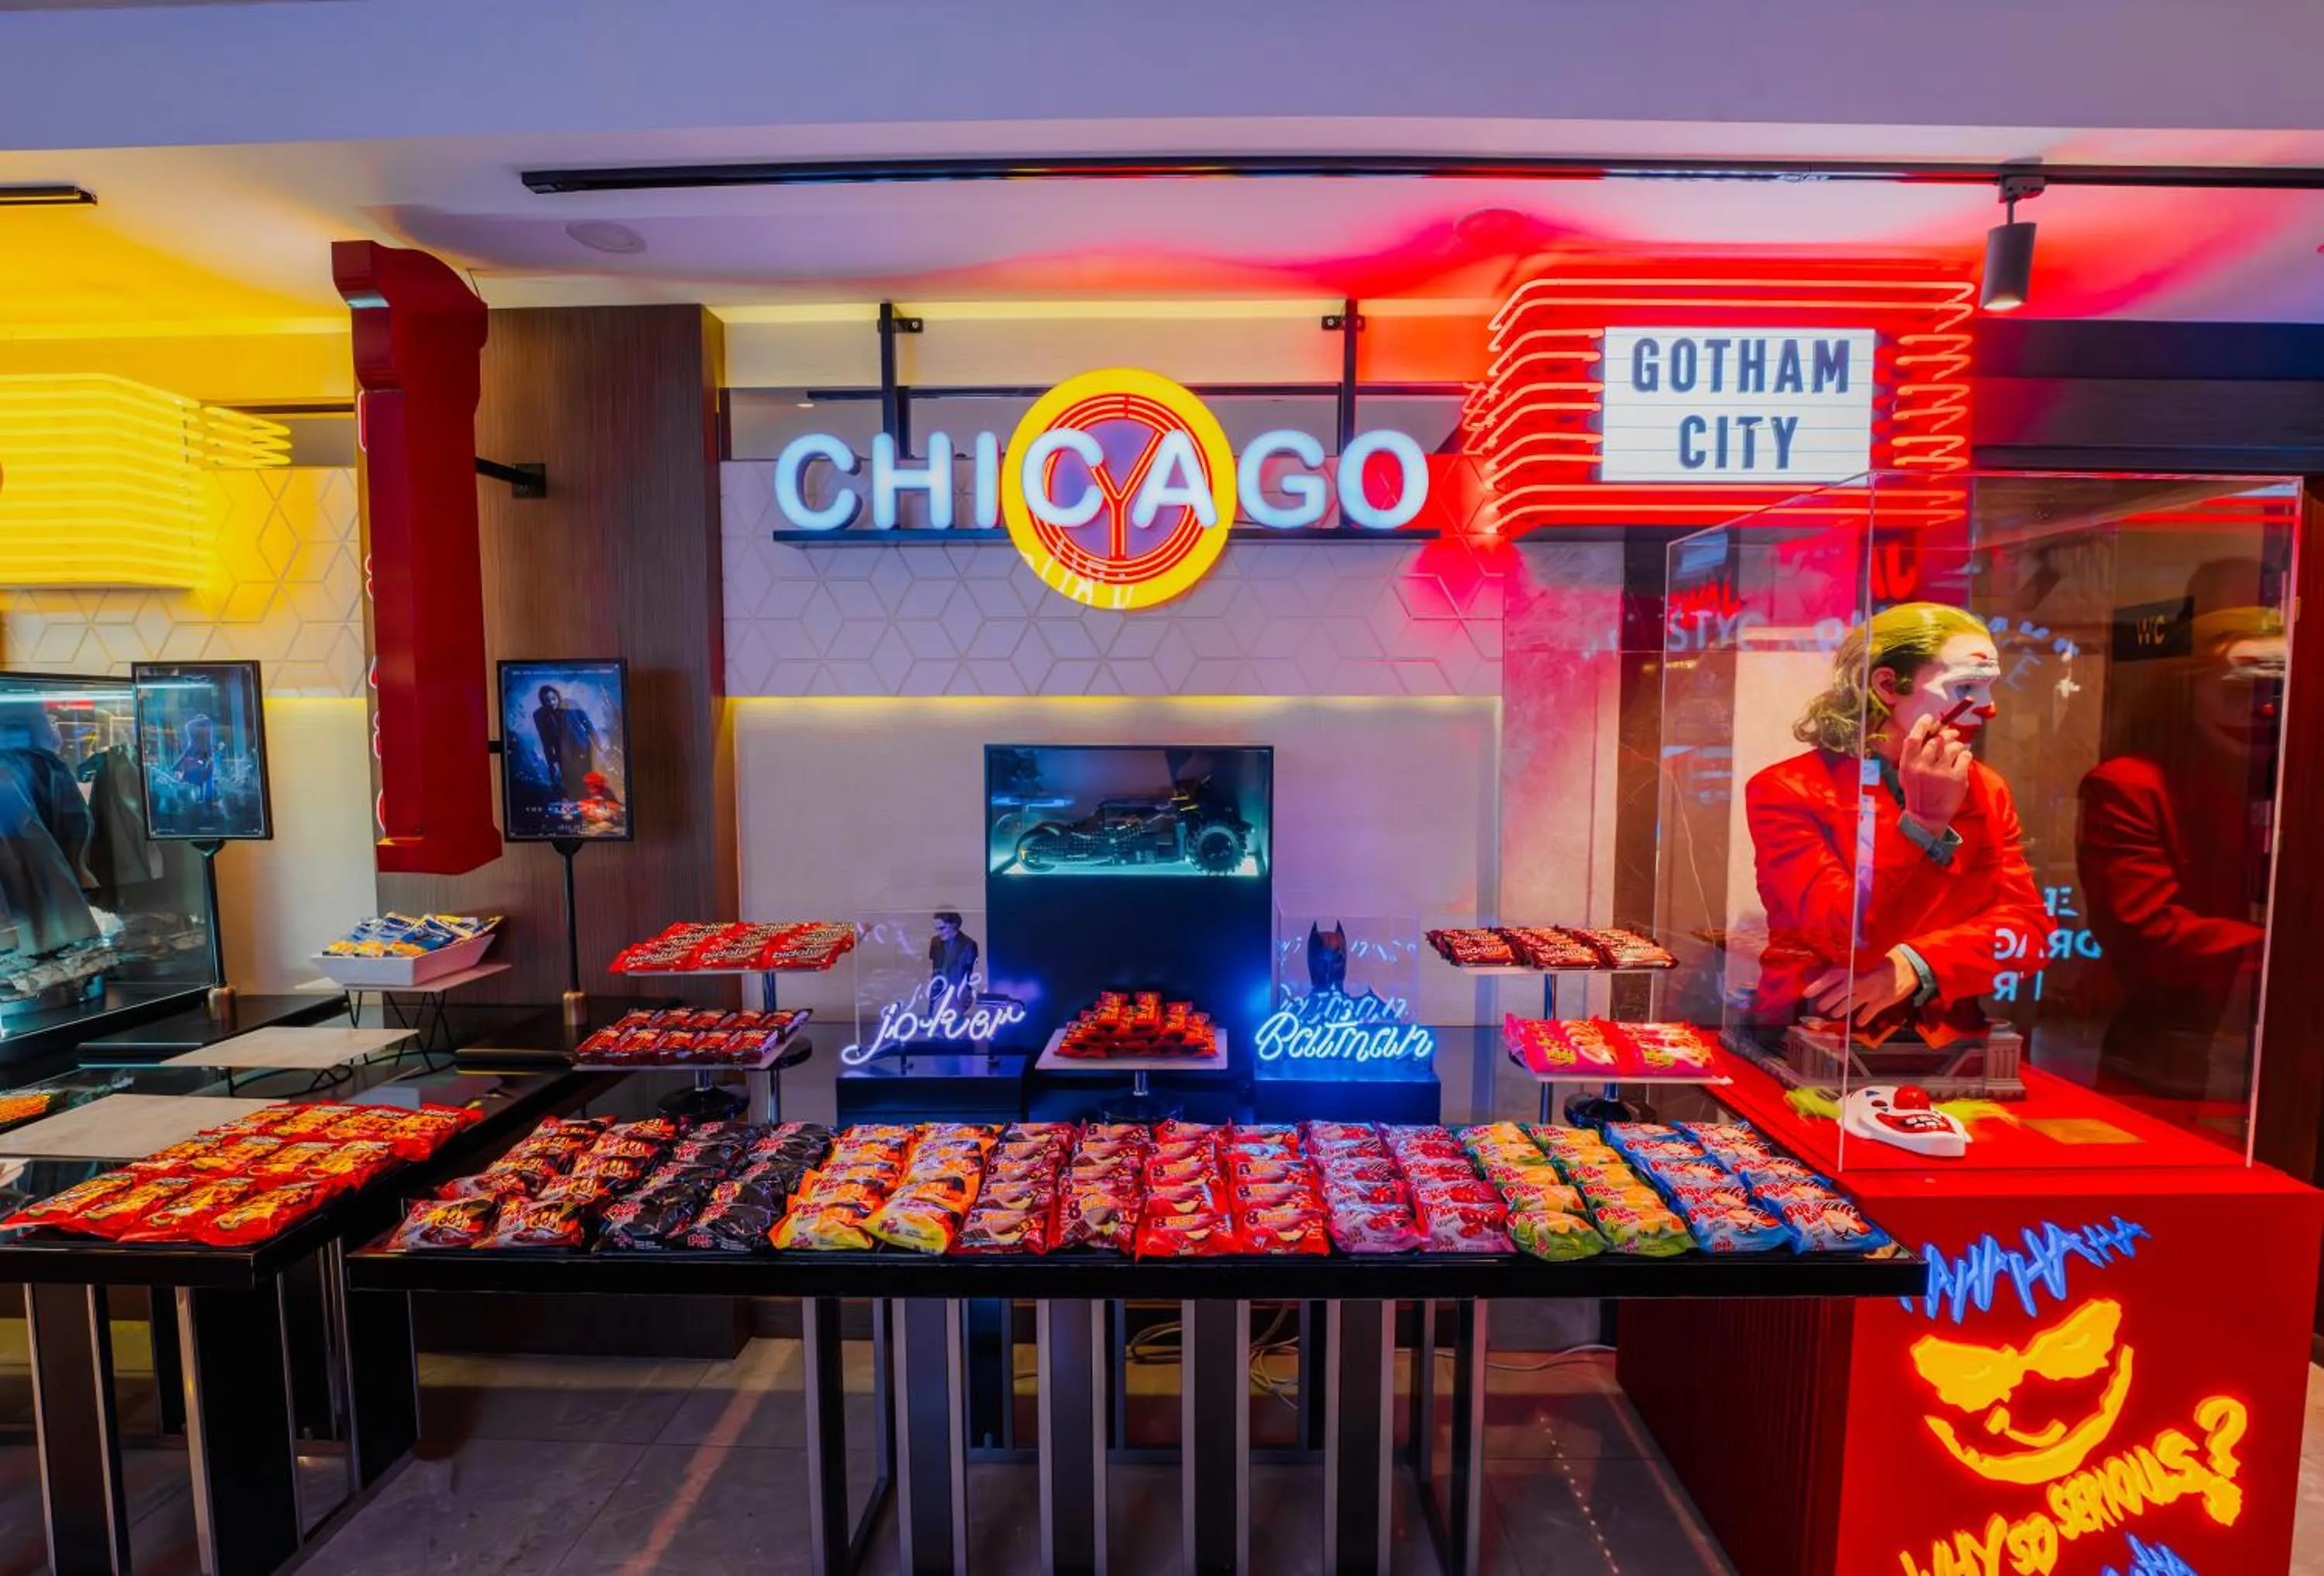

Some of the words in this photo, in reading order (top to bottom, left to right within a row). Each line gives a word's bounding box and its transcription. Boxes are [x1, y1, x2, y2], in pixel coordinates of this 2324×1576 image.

[1632, 338, 1850, 393] GOTHAM
[1679, 415, 1799, 470] CITY
[775, 428, 1428, 530] CHICAGO
[2136, 615, 2167, 645] WC
[841, 1003, 1026, 1065] joker
[1255, 1011, 1433, 1062] Batman
[2006, 1512, 2058, 1576] SO
